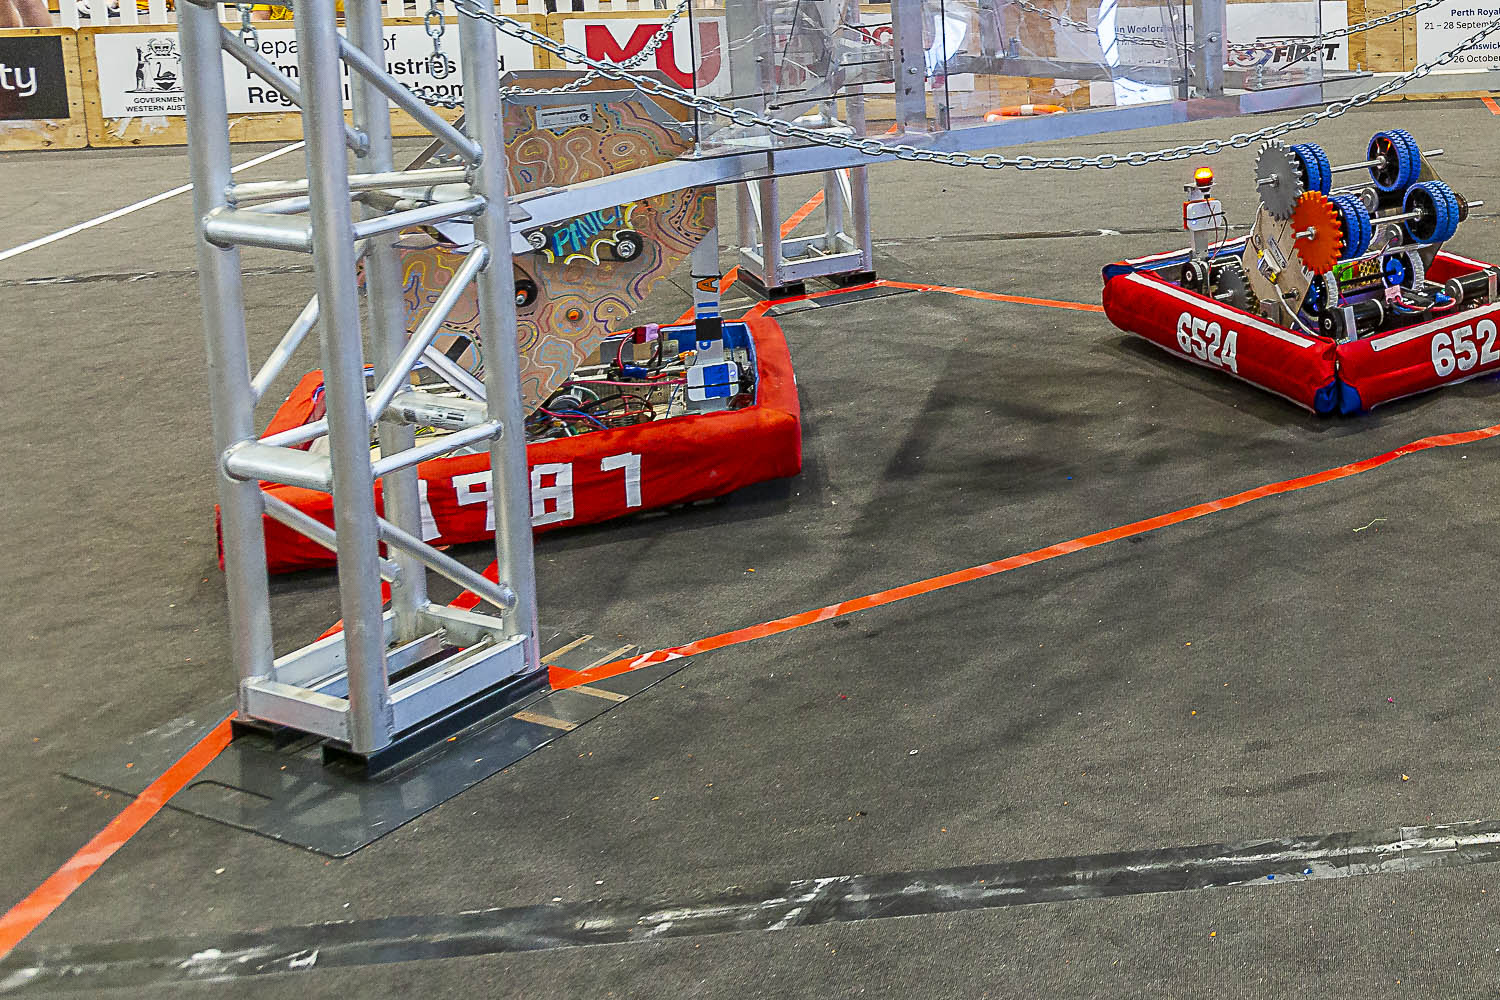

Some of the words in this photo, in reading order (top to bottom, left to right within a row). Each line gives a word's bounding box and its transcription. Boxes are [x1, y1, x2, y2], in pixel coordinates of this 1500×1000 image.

[1424, 22, 1434, 30] 21
[1443, 21, 1455, 29] 28
[1451, 8, 1475, 16] Perth
[585, 22, 722, 89] MU
[1453, 55, 1465, 63] 26
[1466, 54, 1500, 63] October
[552, 204, 624, 257] PANIC!
[1176, 312, 1238, 374] 6524
